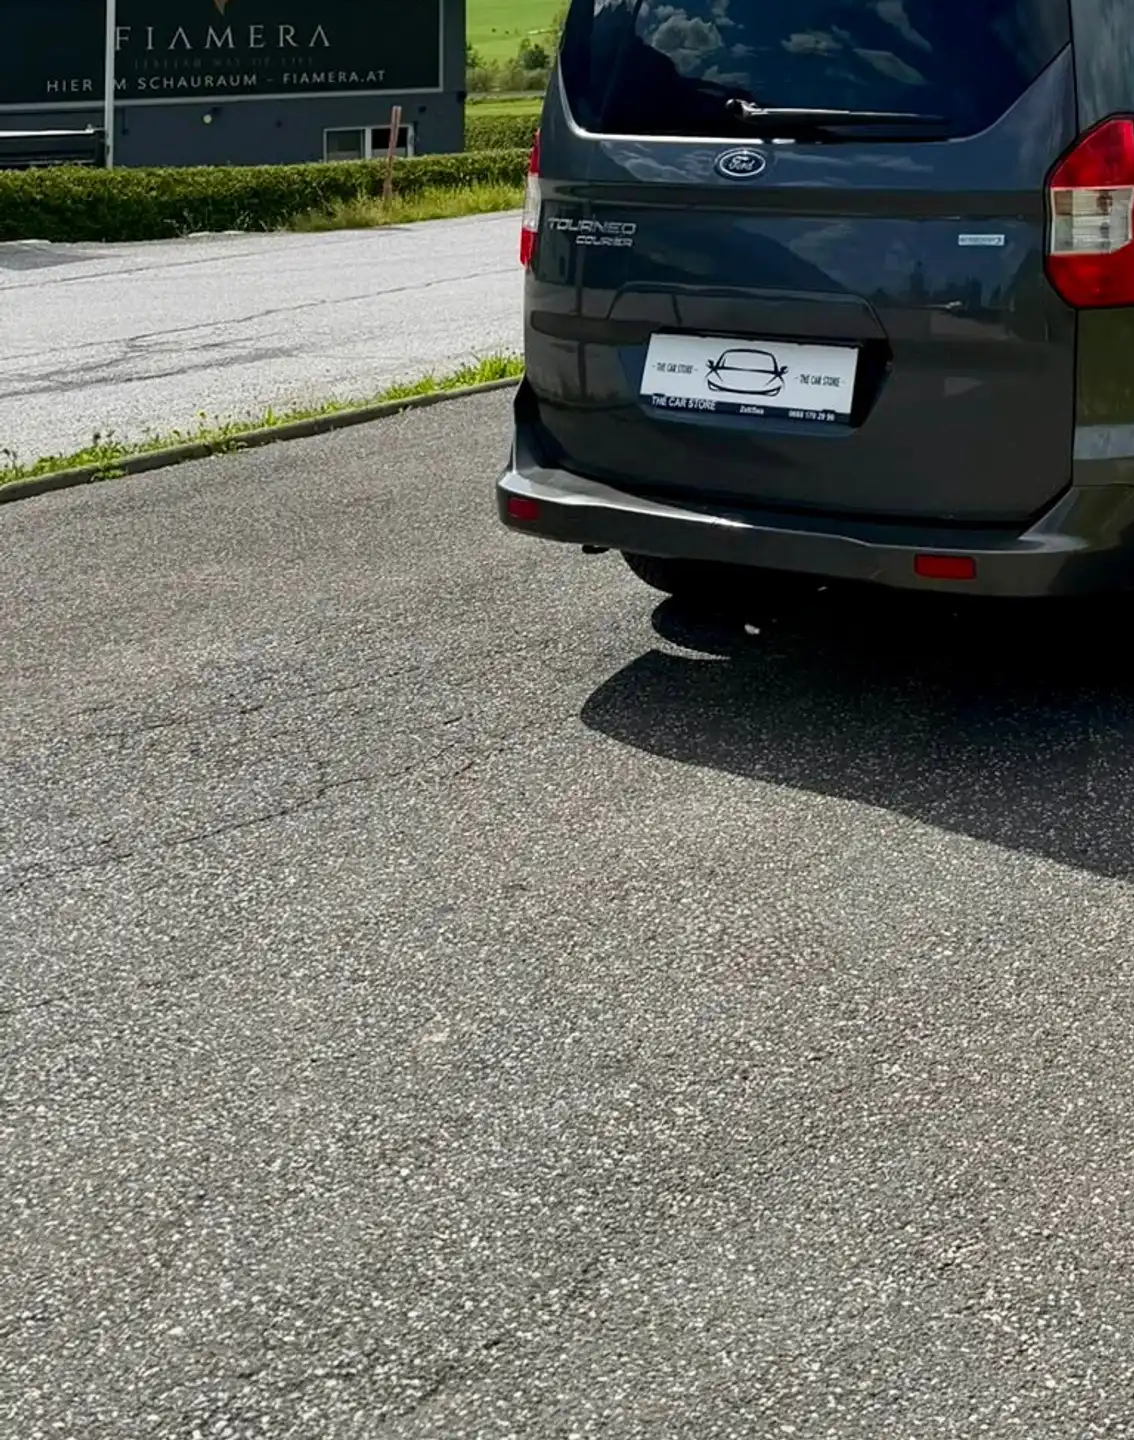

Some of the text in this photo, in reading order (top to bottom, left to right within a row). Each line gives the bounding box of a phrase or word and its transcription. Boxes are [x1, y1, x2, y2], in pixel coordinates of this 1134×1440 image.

[115, 24, 331, 51] FIAMERA
[46, 78, 93, 93] HIER
[137, 74, 257, 90] SCHAURAUM
[282, 69, 386, 85] FIAMERA.AT
[548, 217, 637, 235] TOURNEO
[575, 234, 633, 247] COURIER
[652, 395, 717, 411] THE CAR STORE
